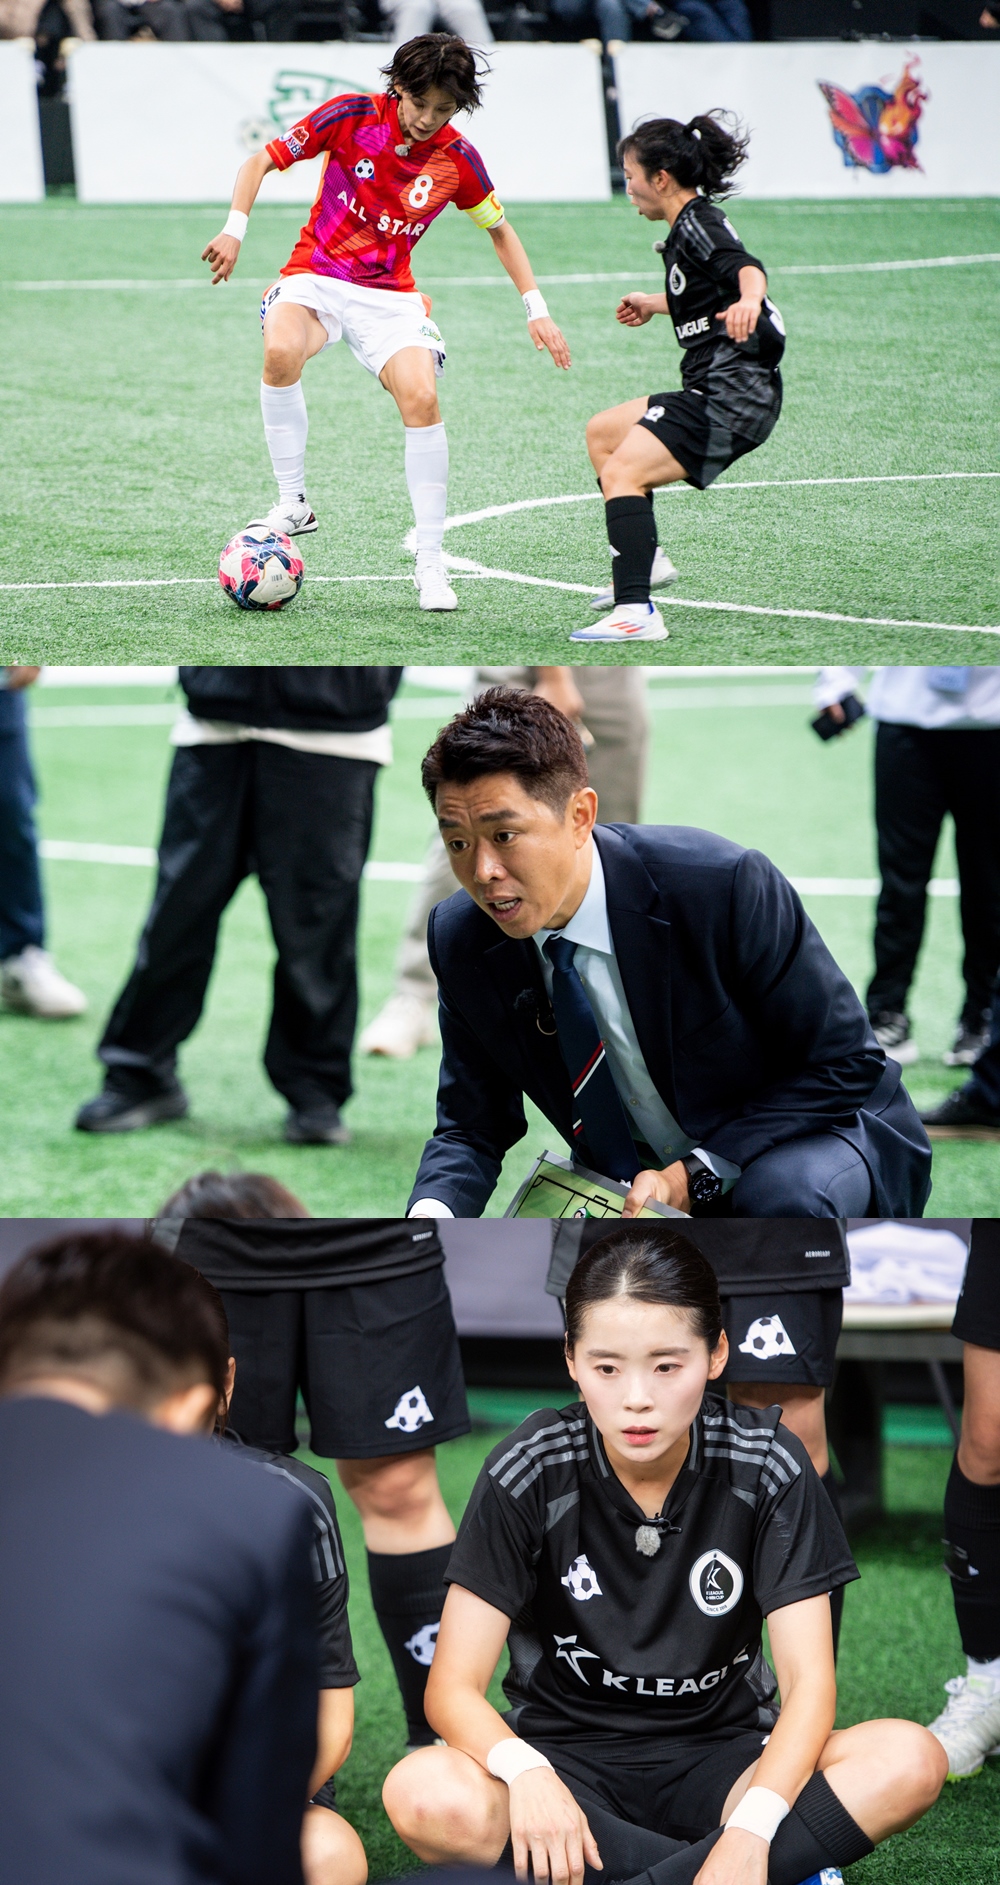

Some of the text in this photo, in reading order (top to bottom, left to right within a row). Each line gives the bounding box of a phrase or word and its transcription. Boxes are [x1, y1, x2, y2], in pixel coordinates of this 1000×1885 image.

[408, 174, 434, 209] 8
[337, 190, 425, 236] ALL STAR
[602, 1668, 631, 1692] K
